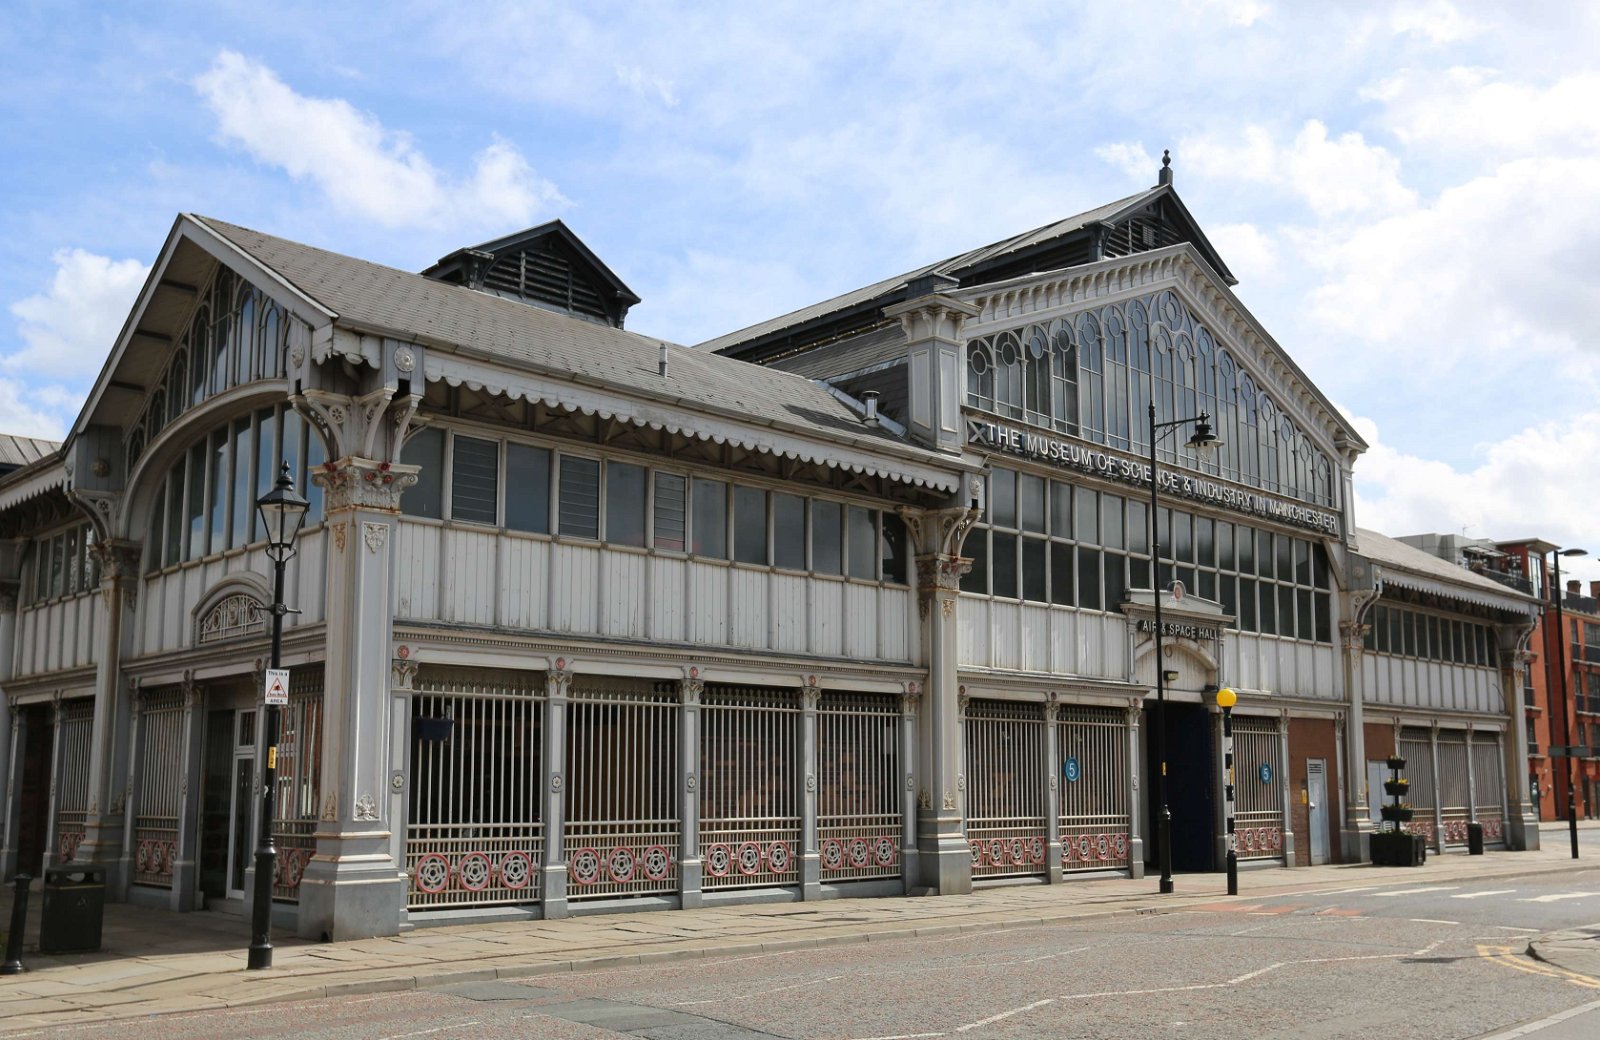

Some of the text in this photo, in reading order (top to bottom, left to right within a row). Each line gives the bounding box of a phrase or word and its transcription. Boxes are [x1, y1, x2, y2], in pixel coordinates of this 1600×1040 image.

[986, 423, 1337, 530] THE MUSEUM OF SCIENCE & INDUSTRY IN MANCHESTER
[1161, 622, 1167, 635] &
[1169, 623, 1196, 639] SPACE
[1198, 628, 1219, 640] HALL
[1069, 762, 1075, 777] 5
[1263, 767, 1269, 780] 5
